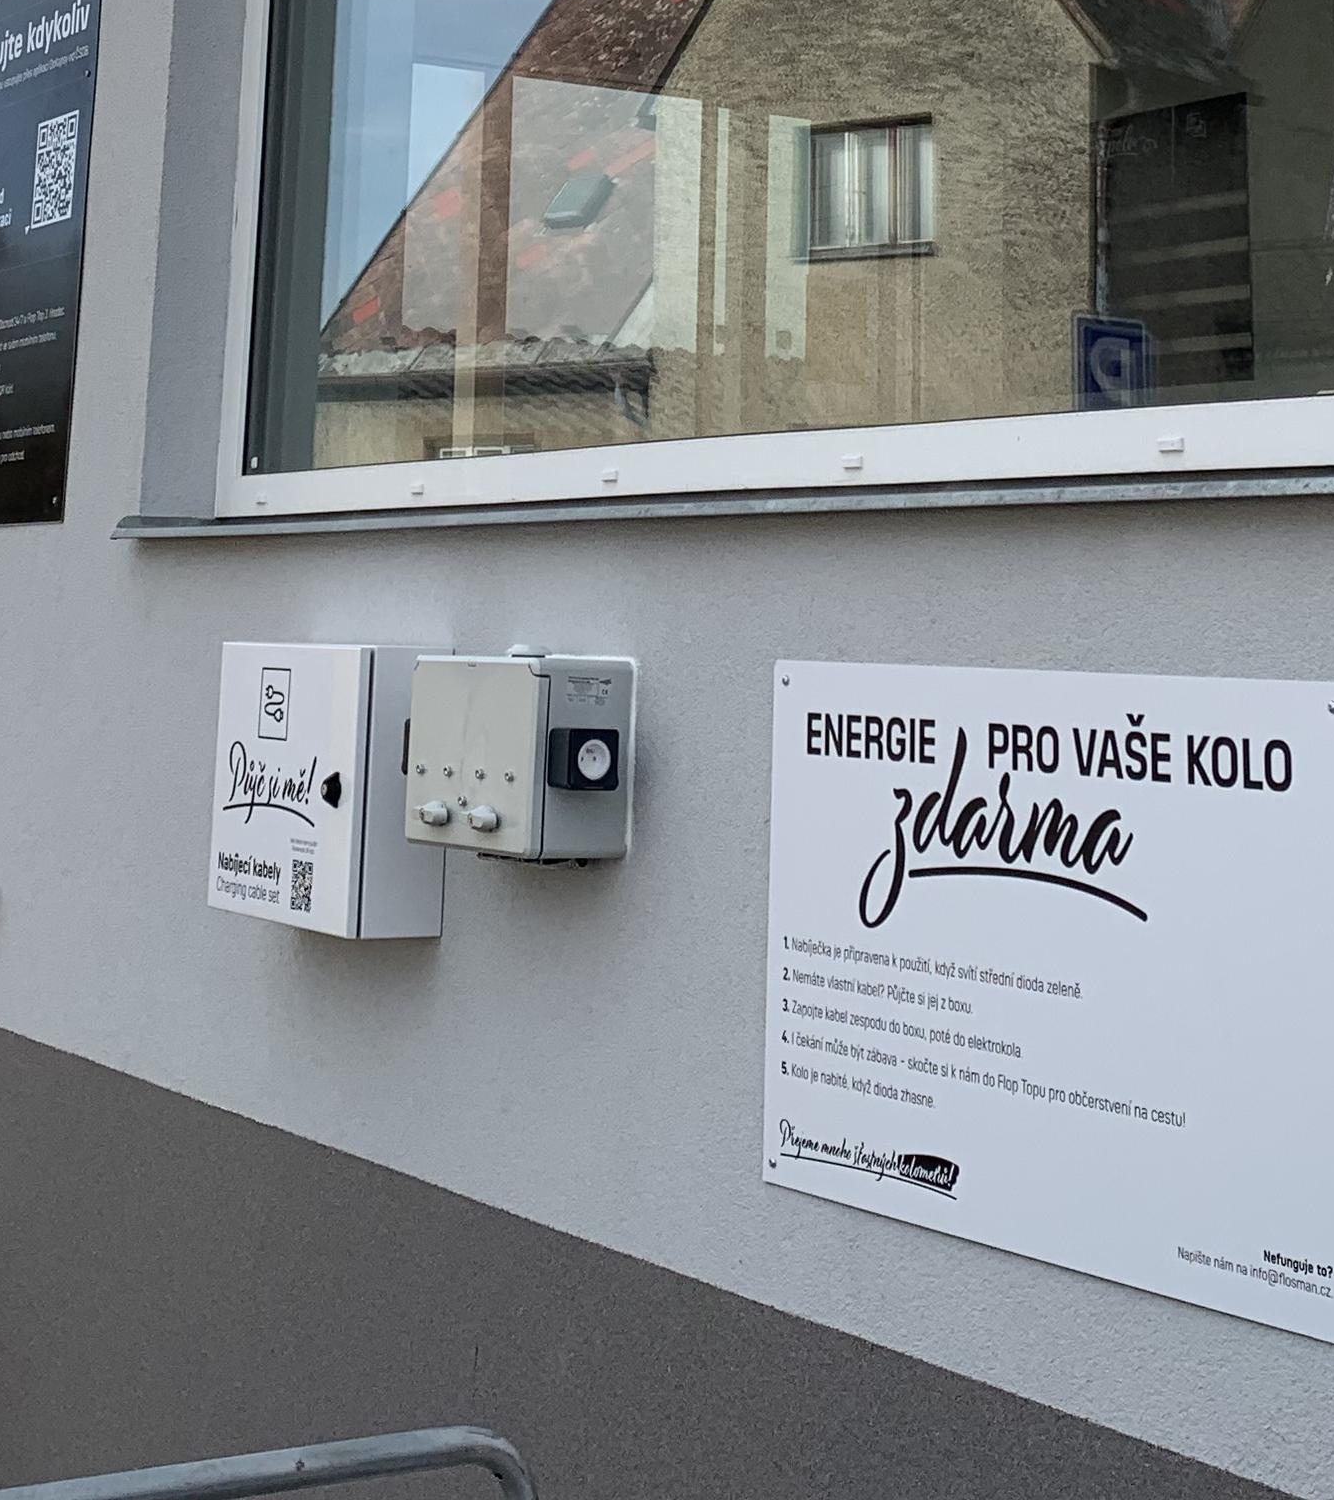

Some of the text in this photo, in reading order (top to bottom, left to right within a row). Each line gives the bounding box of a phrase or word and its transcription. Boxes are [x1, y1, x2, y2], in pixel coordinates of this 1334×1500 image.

[806, 712, 1292, 792] ENERGIE PRO VAŠE KOLO
[229, 741, 317, 824] Půjč si mě!
[858, 726, 1134, 928] zdarma
[216, 876, 280, 904] Charging cable set
[218, 851, 281, 886] Nabíjecí kabely
[783, 967, 973, 1015] 2. Nemáte vlastní kabel? Půjčte si jej z boxu.
[784, 936, 1083, 999] 1. Nabíječka je připravena k použití, když svítí střední dioda zeleně.
[782, 998, 790, 1012] 3.
[791, 1000, 823, 1020] Zapojte
[825, 1005, 848, 1023] kabel
[850, 1012, 887, 1032] zespodu
[889, 1019, 901, 1034] do
[903, 1021, 927, 1041] boxu,
[929, 1027, 951, 1048] poté
[953, 1031, 965, 1047] do
[781, 1030, 790, 1044] 4.
[796, 1032, 823, 1050] čekání
[825, 1038, 849, 1056] může
[850, 1043, 865, 1060] být
[867, 1047, 897, 1067] zábava
[908, 1057, 938, 1075] skočte
[941, 1063, 949, 1077] si
[951, 1064, 956, 1079] k
[959, 1066, 980, 1084] nám
[982, 1071, 995, 1087] do
[997, 1074, 1018, 1096] Flop
[1021, 1079, 1046, 1100] Topu
[1049, 1086, 1066, 1103] pro
[1068, 1089, 1131, 1117] občerstvení
[1134, 1103, 1148, 1120] na
[1151, 1106, 1186, 1128] cestu!
[781, 1061, 937, 1109] 5. Kolo je nabité, když dioda zhasne.
[779, 1119, 820, 1160] Přejeme
[821, 1138, 852, 1160] mnoho
[853, 1142, 897, 1182] šťastných
[1178, 1246, 1212, 1267] Napište
[1213, 1256, 1234, 1273] nám
[1236, 1263, 1248, 1276] na
[1263, 1250, 1334, 1279] Nefunguje to?
